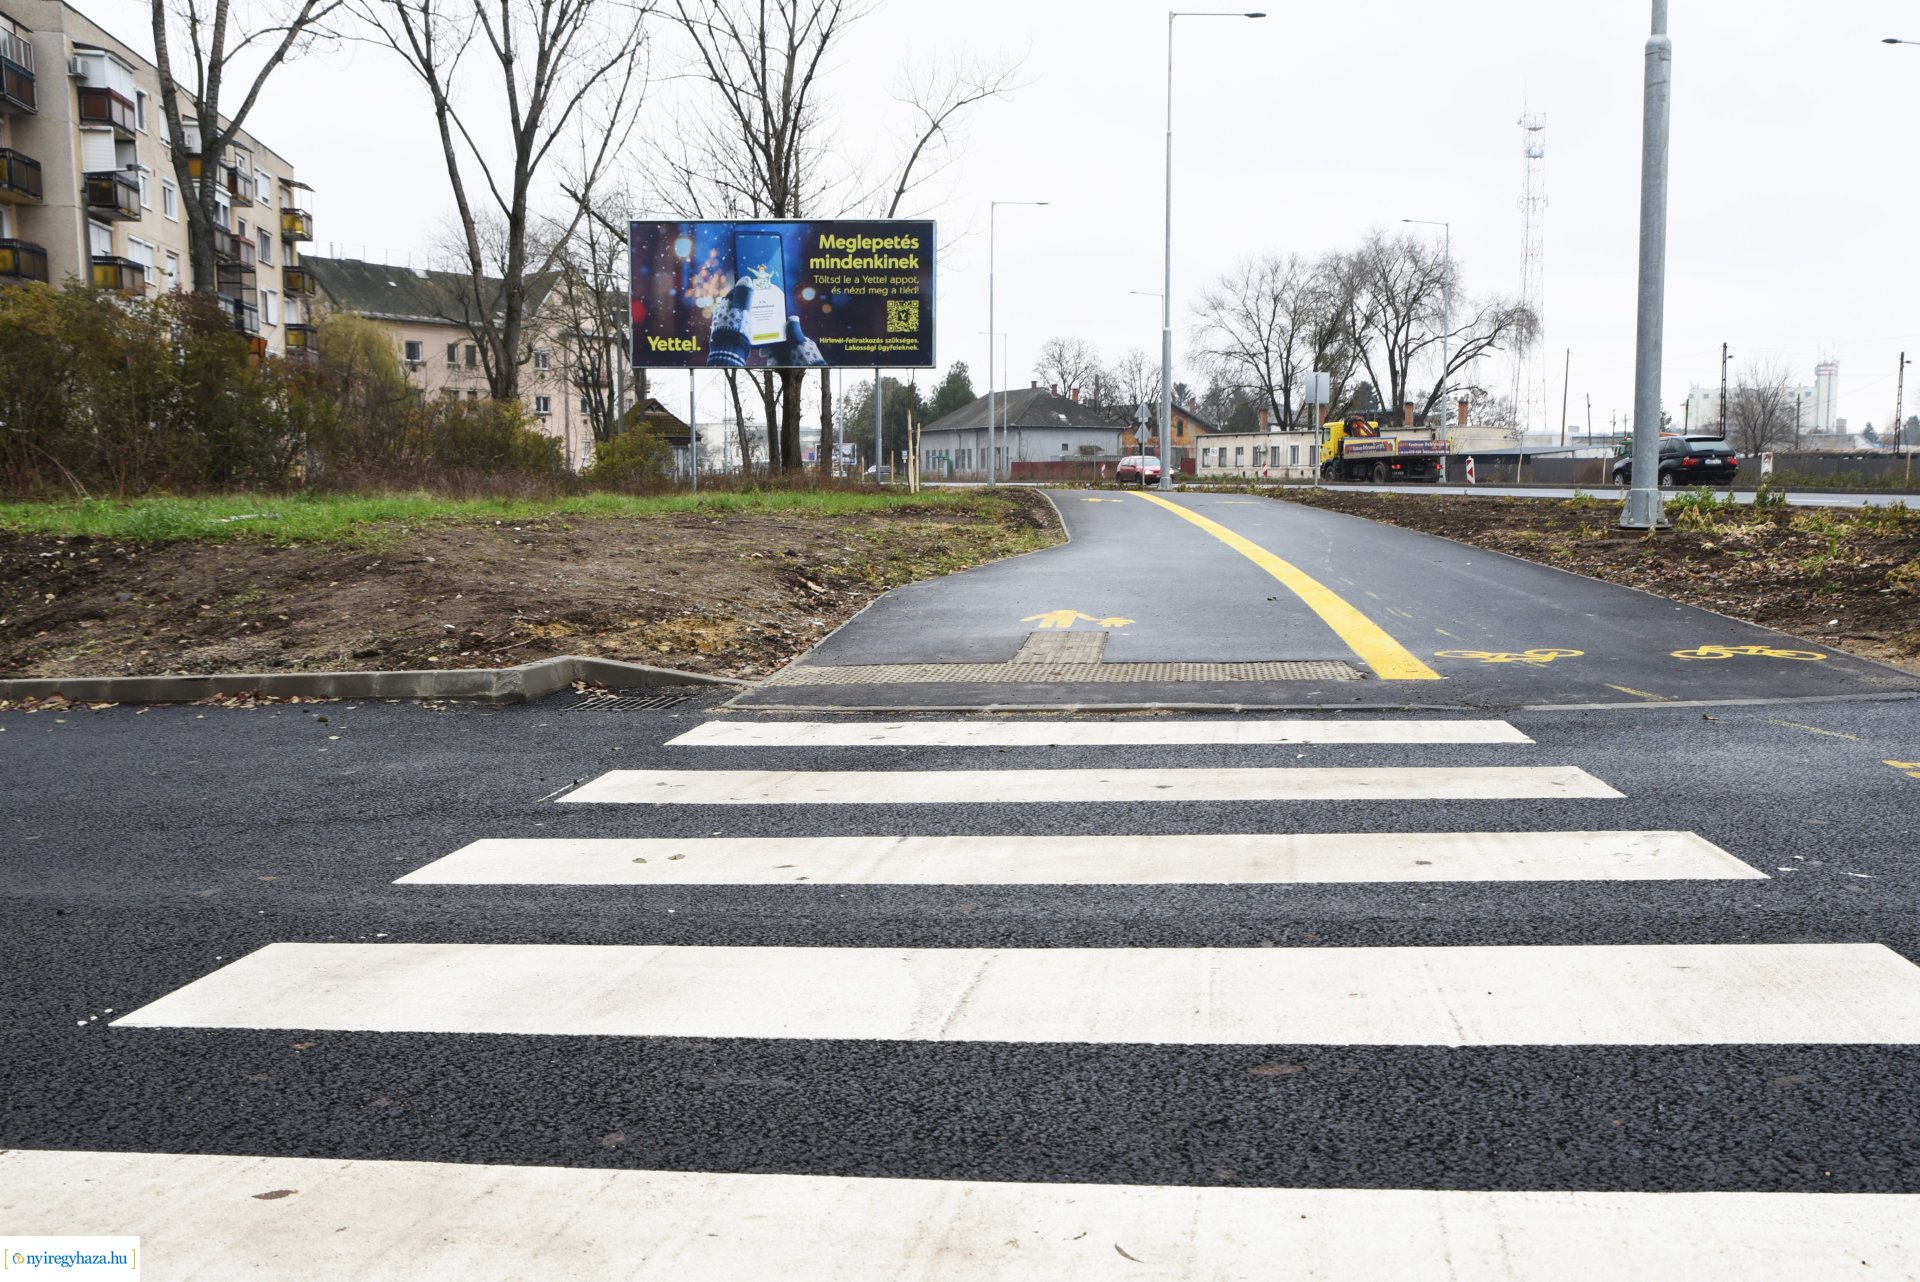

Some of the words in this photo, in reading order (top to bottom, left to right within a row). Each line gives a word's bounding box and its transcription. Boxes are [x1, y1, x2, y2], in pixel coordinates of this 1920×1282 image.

[819, 234, 919, 253] Meglepetés
[809, 254, 919, 269] mindenkinek
[813, 275, 841, 284] Töltsd
[843, 275, 852, 284] le
[862, 275, 887, 284] Yettel
[890, 276, 919, 285] appot,
[831, 286, 841, 295] és
[843, 286, 866, 295] nézd
[899, 286, 919, 295] tiéd!
[647, 336, 701, 351] Yettel.
[885, 337, 919, 345] szükséges.
